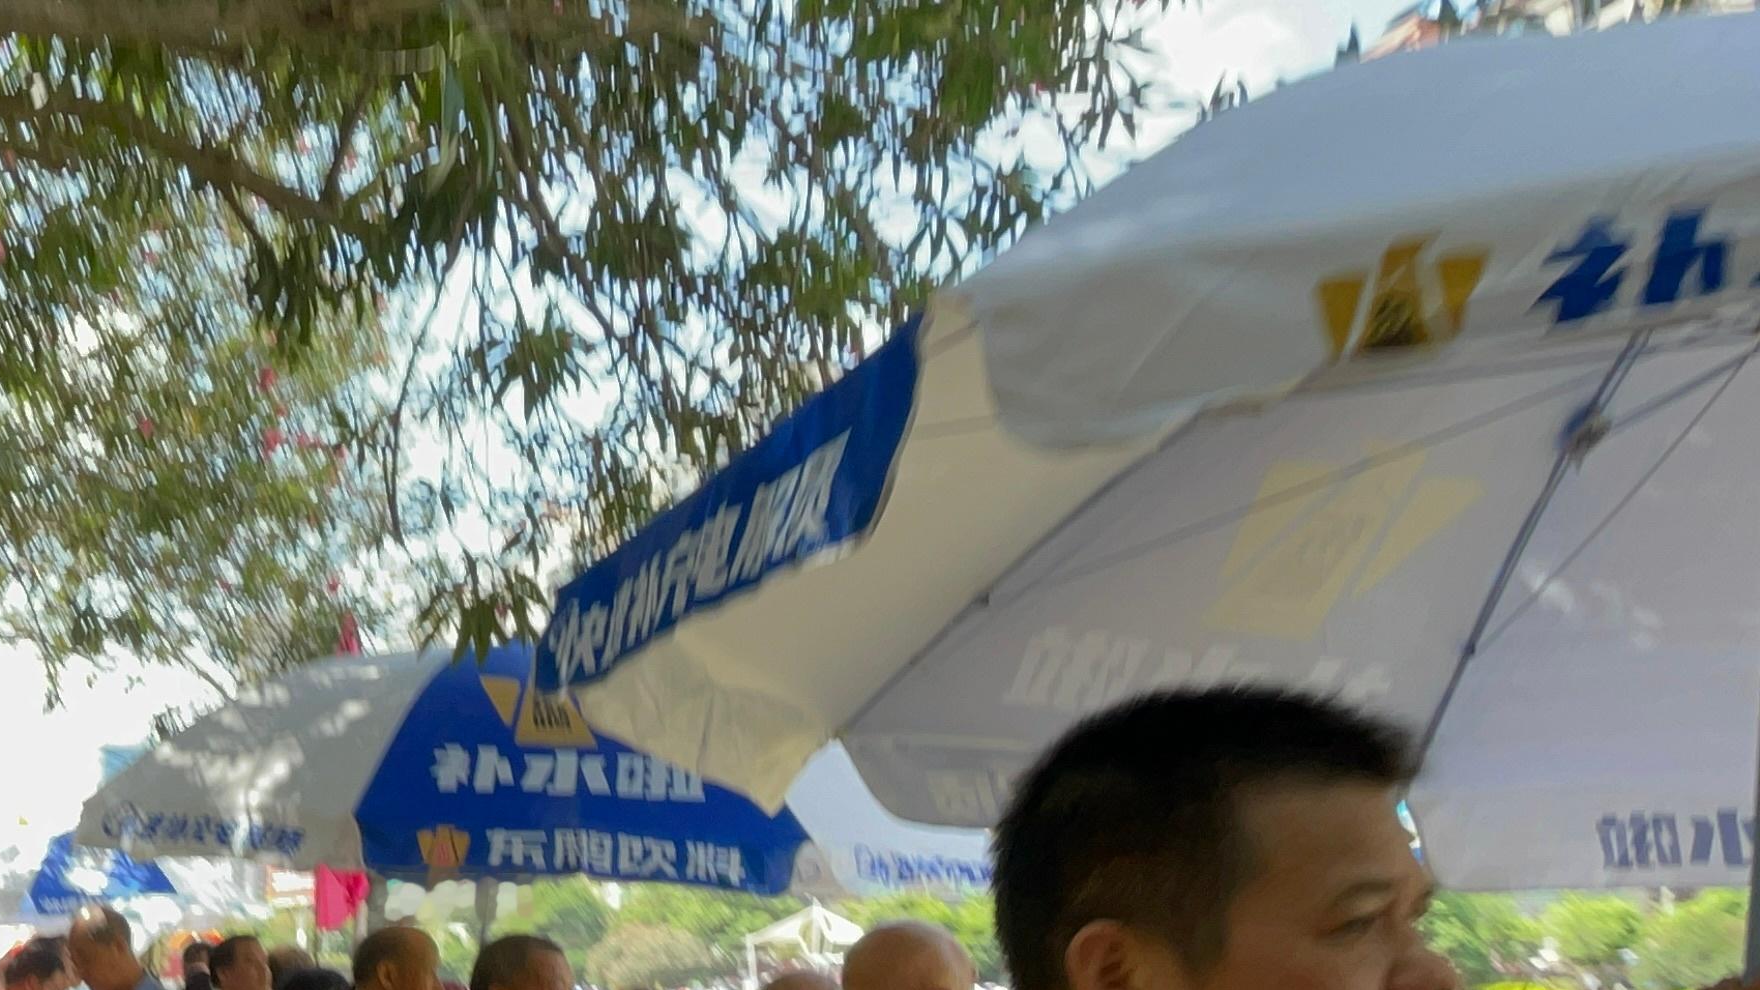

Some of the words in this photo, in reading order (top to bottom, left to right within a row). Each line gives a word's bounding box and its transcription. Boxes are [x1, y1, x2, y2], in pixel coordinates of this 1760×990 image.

[1525, 208, 1760, 322] 补
[429, 742, 706, 803] 补水啦
[485, 827, 747, 887] 东鹏饮料
